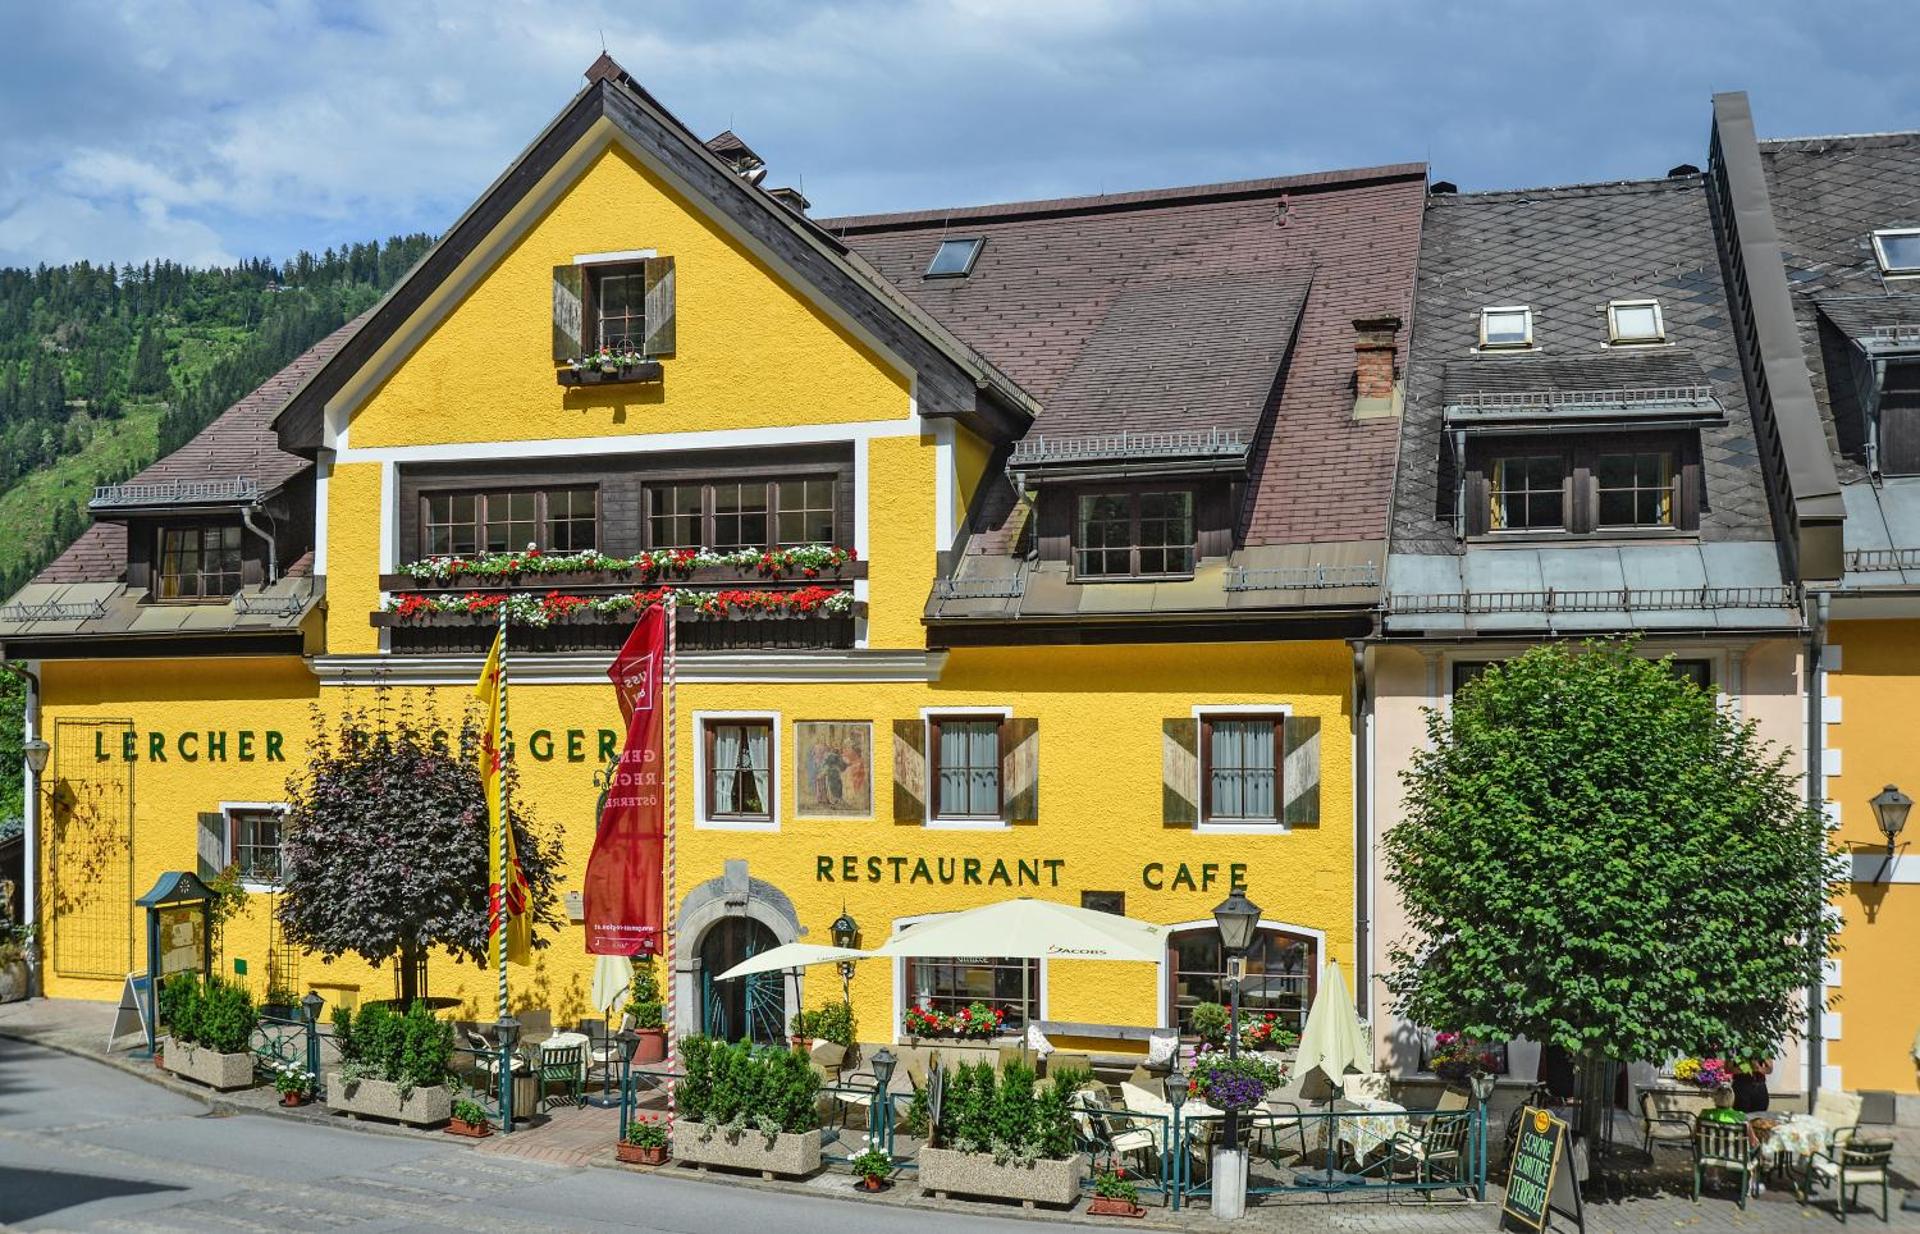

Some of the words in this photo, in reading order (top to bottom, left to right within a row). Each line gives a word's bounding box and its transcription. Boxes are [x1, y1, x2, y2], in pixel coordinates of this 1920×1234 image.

[95, 730, 286, 763] LERCHER
[816, 855, 1065, 887] RESTAURANT
[1142, 862, 1248, 892] CAFE
[1048, 944, 1107, 955] JACOBS
